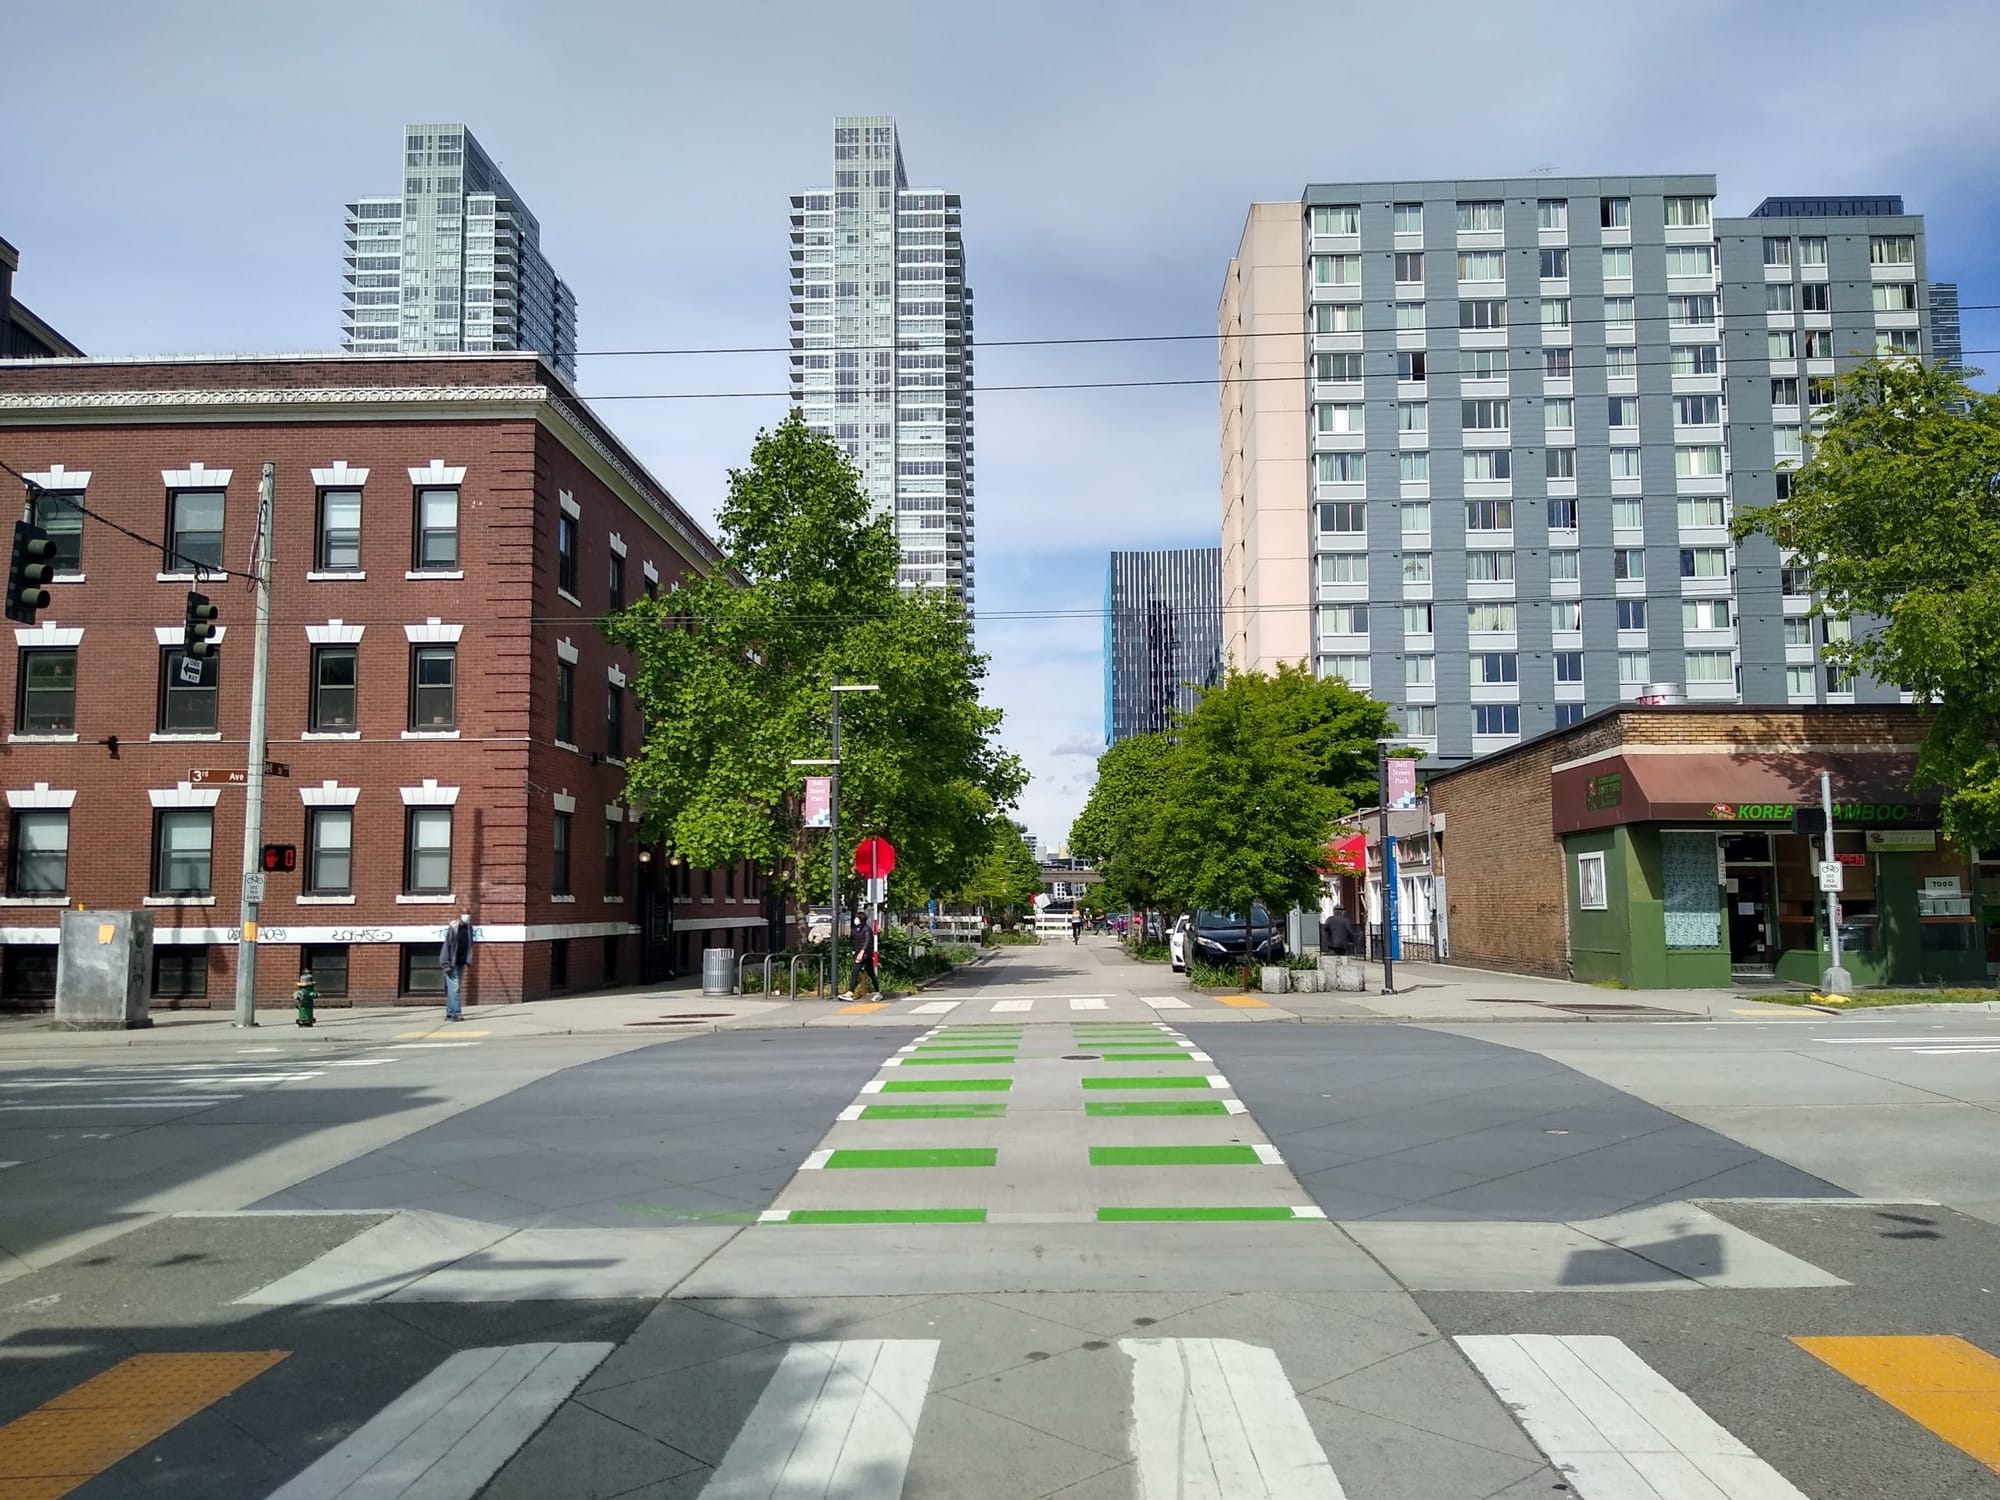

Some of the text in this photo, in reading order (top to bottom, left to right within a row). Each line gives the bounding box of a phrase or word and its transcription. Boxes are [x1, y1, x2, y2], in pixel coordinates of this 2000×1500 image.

[189, 659, 200, 668] ONE
[193, 770, 245, 782] 3rd Ave
[1392, 769, 1411, 777] Street
